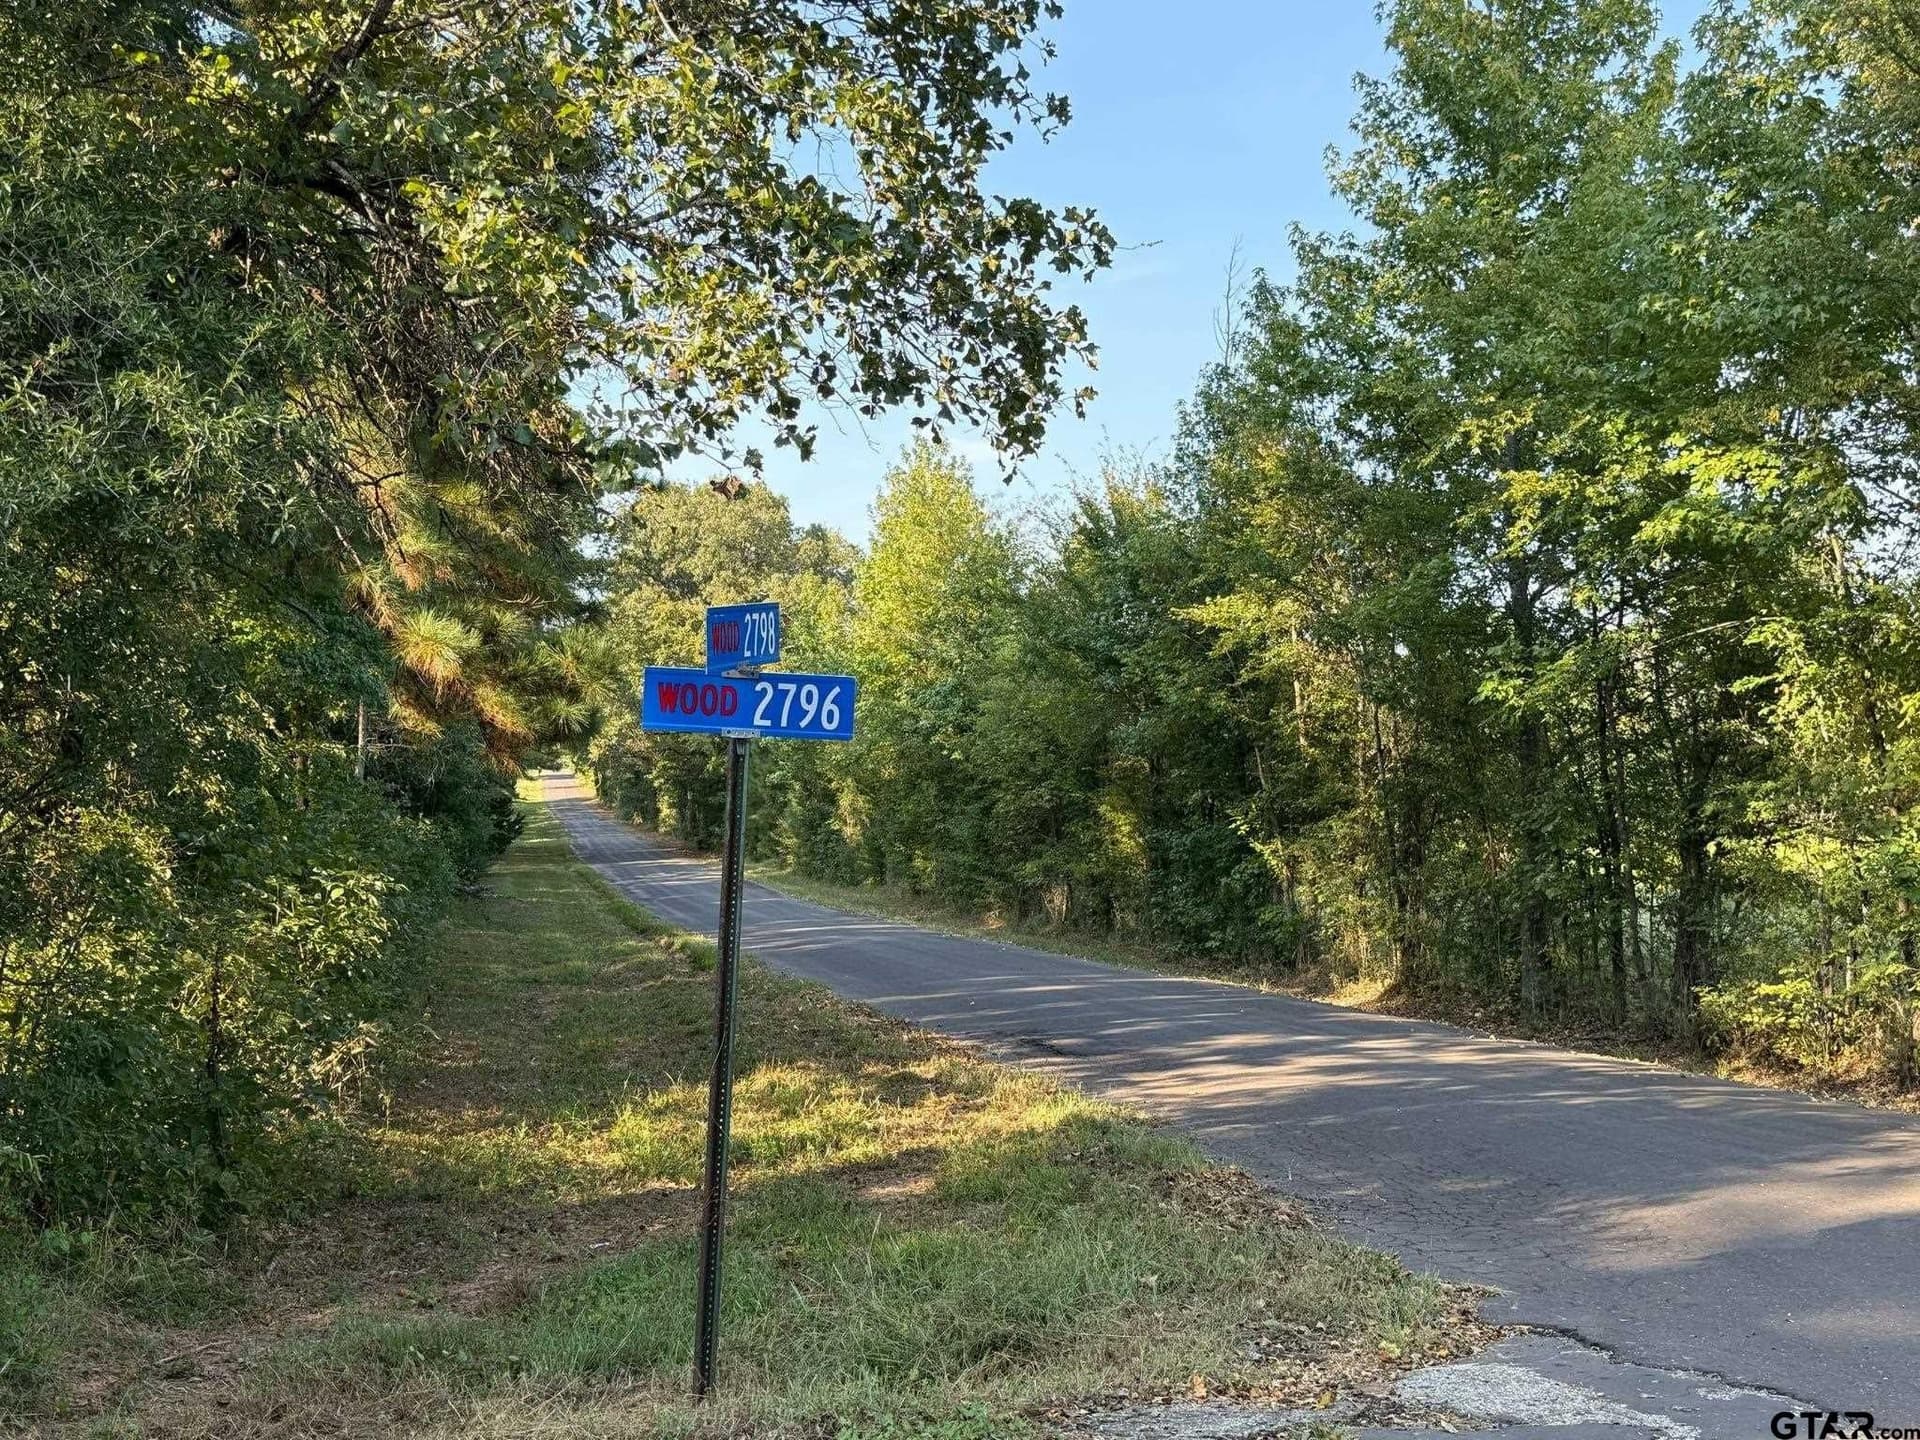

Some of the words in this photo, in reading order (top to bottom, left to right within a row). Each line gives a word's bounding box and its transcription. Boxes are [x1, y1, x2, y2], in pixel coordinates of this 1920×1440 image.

[712, 622, 739, 655] WOOD
[744, 611, 775, 657] 2798
[658, 682, 738, 716] WOOD
[753, 681, 840, 731] 2796
